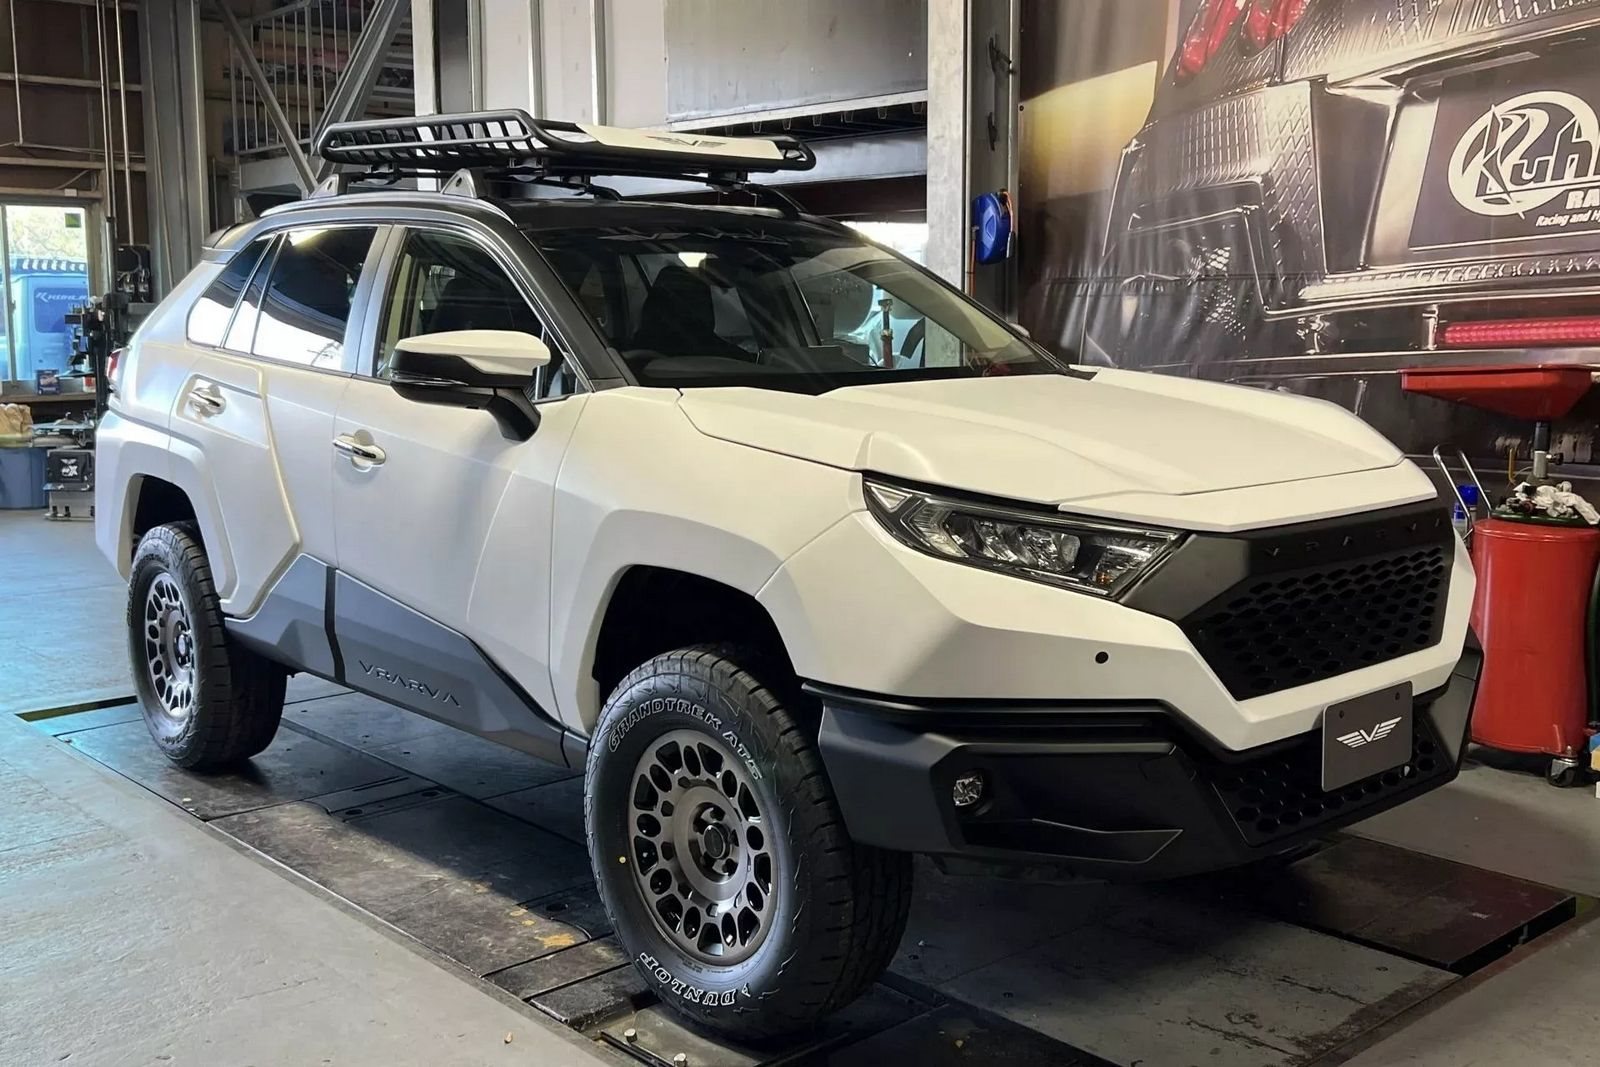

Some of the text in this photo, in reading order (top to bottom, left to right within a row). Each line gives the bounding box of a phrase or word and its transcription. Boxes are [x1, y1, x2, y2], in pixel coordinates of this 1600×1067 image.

[1536, 214, 1570, 226] Racing
[1570, 210, 1592, 223] and
[359, 660, 461, 707] VRARVA
[608, 698, 722, 752] GRANDTREK
[639, 952, 737, 1006] DUNLOP
